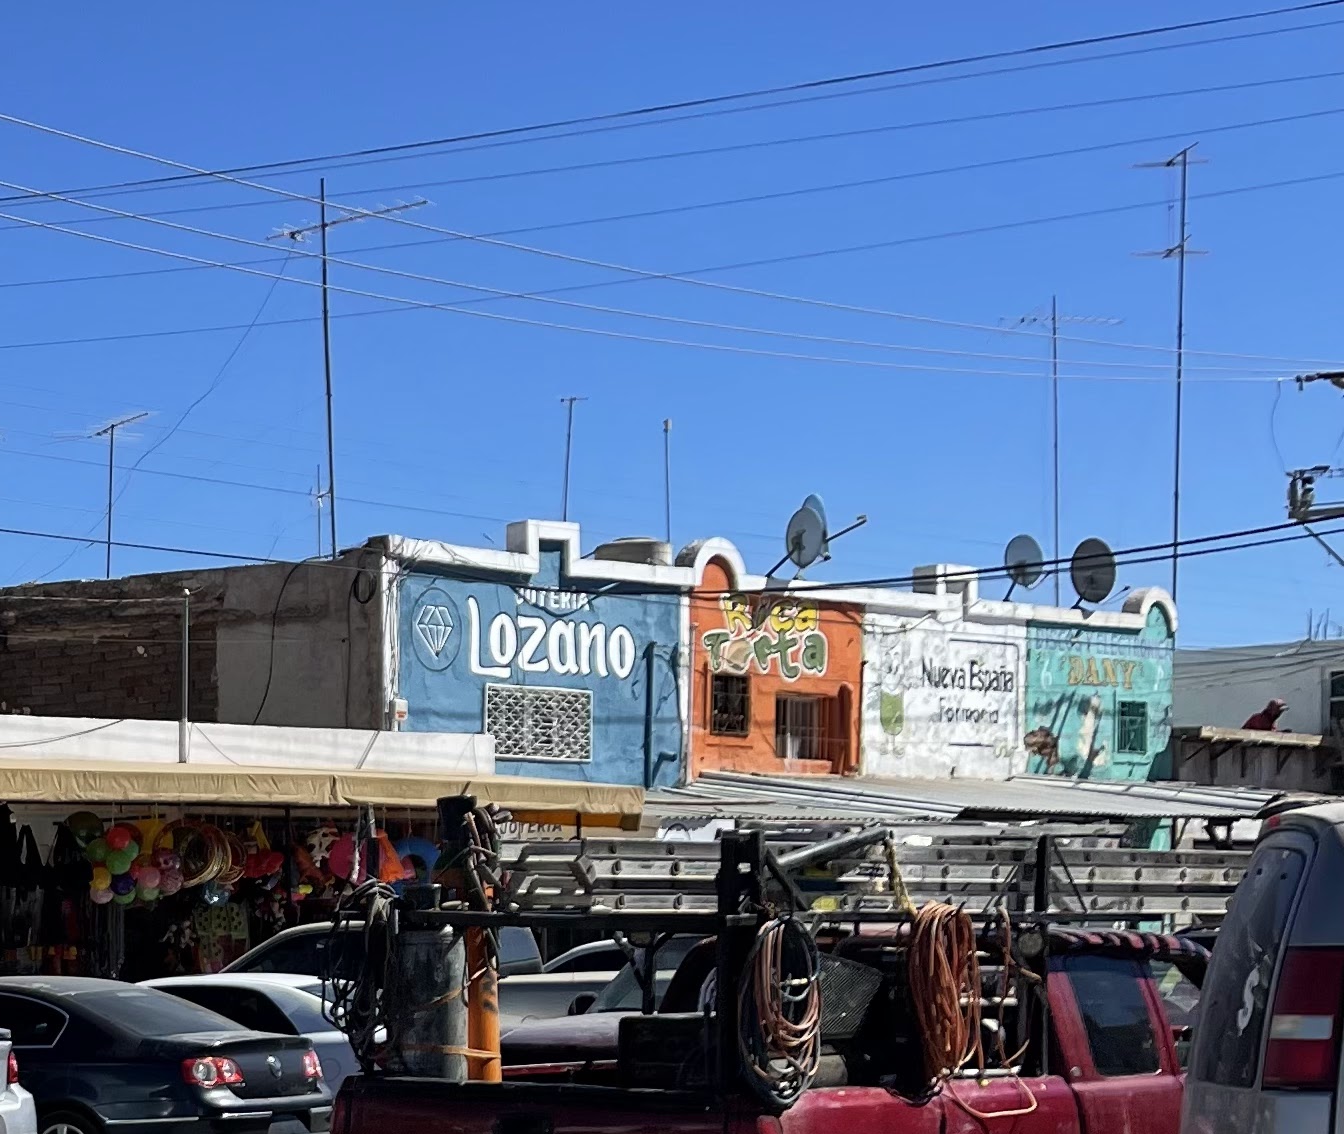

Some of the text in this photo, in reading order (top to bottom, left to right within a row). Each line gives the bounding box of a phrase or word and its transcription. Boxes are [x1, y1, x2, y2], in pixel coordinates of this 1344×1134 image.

[468, 595, 636, 680] Lozano
[920, 656, 1014, 697] Nueva España
